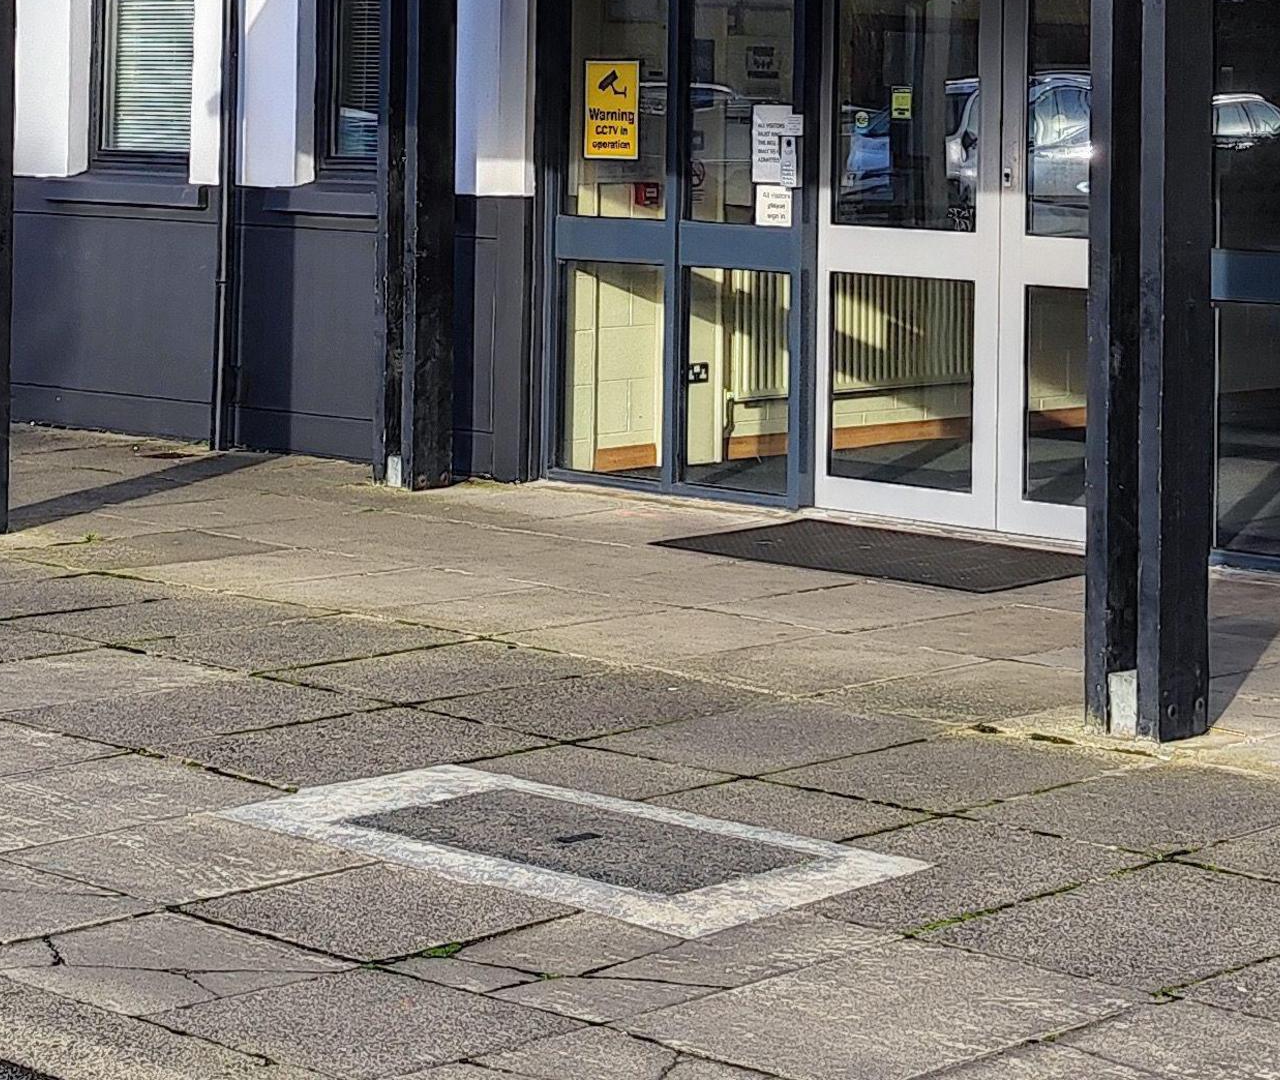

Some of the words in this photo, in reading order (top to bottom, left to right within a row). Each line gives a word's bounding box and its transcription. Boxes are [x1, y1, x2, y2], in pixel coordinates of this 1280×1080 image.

[589, 108, 635, 125] Warning
[595, 125, 619, 135] CCTV
[592, 139, 630, 150] operation
